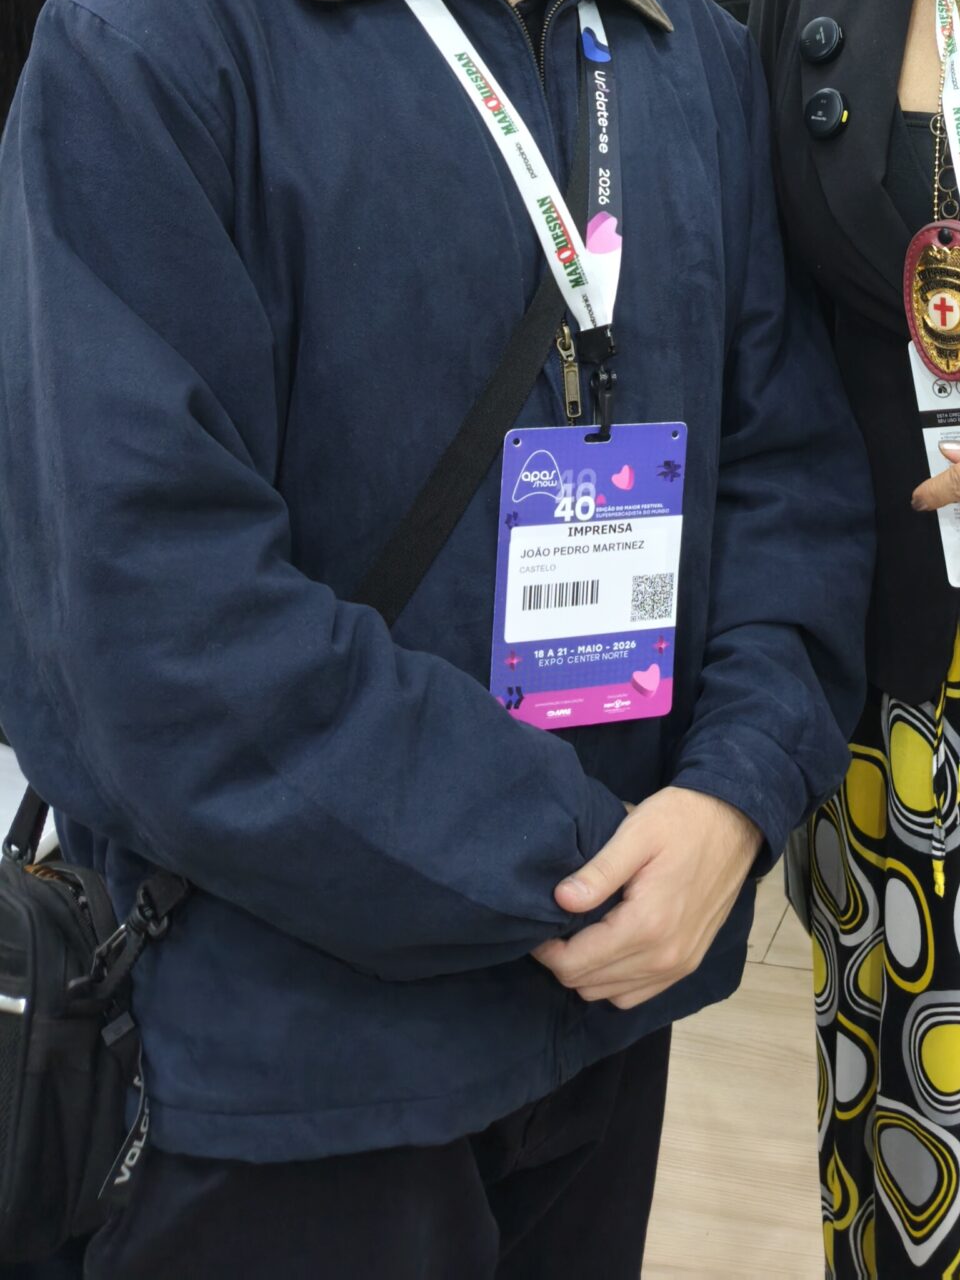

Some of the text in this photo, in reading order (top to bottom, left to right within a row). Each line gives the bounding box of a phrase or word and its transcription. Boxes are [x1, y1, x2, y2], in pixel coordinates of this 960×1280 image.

[453, 51, 517, 137] MARQUESPAN
[598, 167, 611, 206] 2026
[536, 195, 586, 289] MARQUESPAN
[521, 470, 556, 482] apas
[532, 479, 558, 488] show
[554, 496, 596, 522] 40
[567, 523, 633, 537] IMPRENSA
[520, 540, 645, 559] JOÃO PEDRO MARTINEZ
[519, 563, 556, 574] CASTELO
[534, 650, 544, 659] 18
[547, 649, 555, 657] A
[557, 648, 568, 656] 21
[577, 644, 603, 654] MAIO
[613, 640, 637, 651] 2026
[538, 650, 629, 667] EXPO CENTER NORTE
